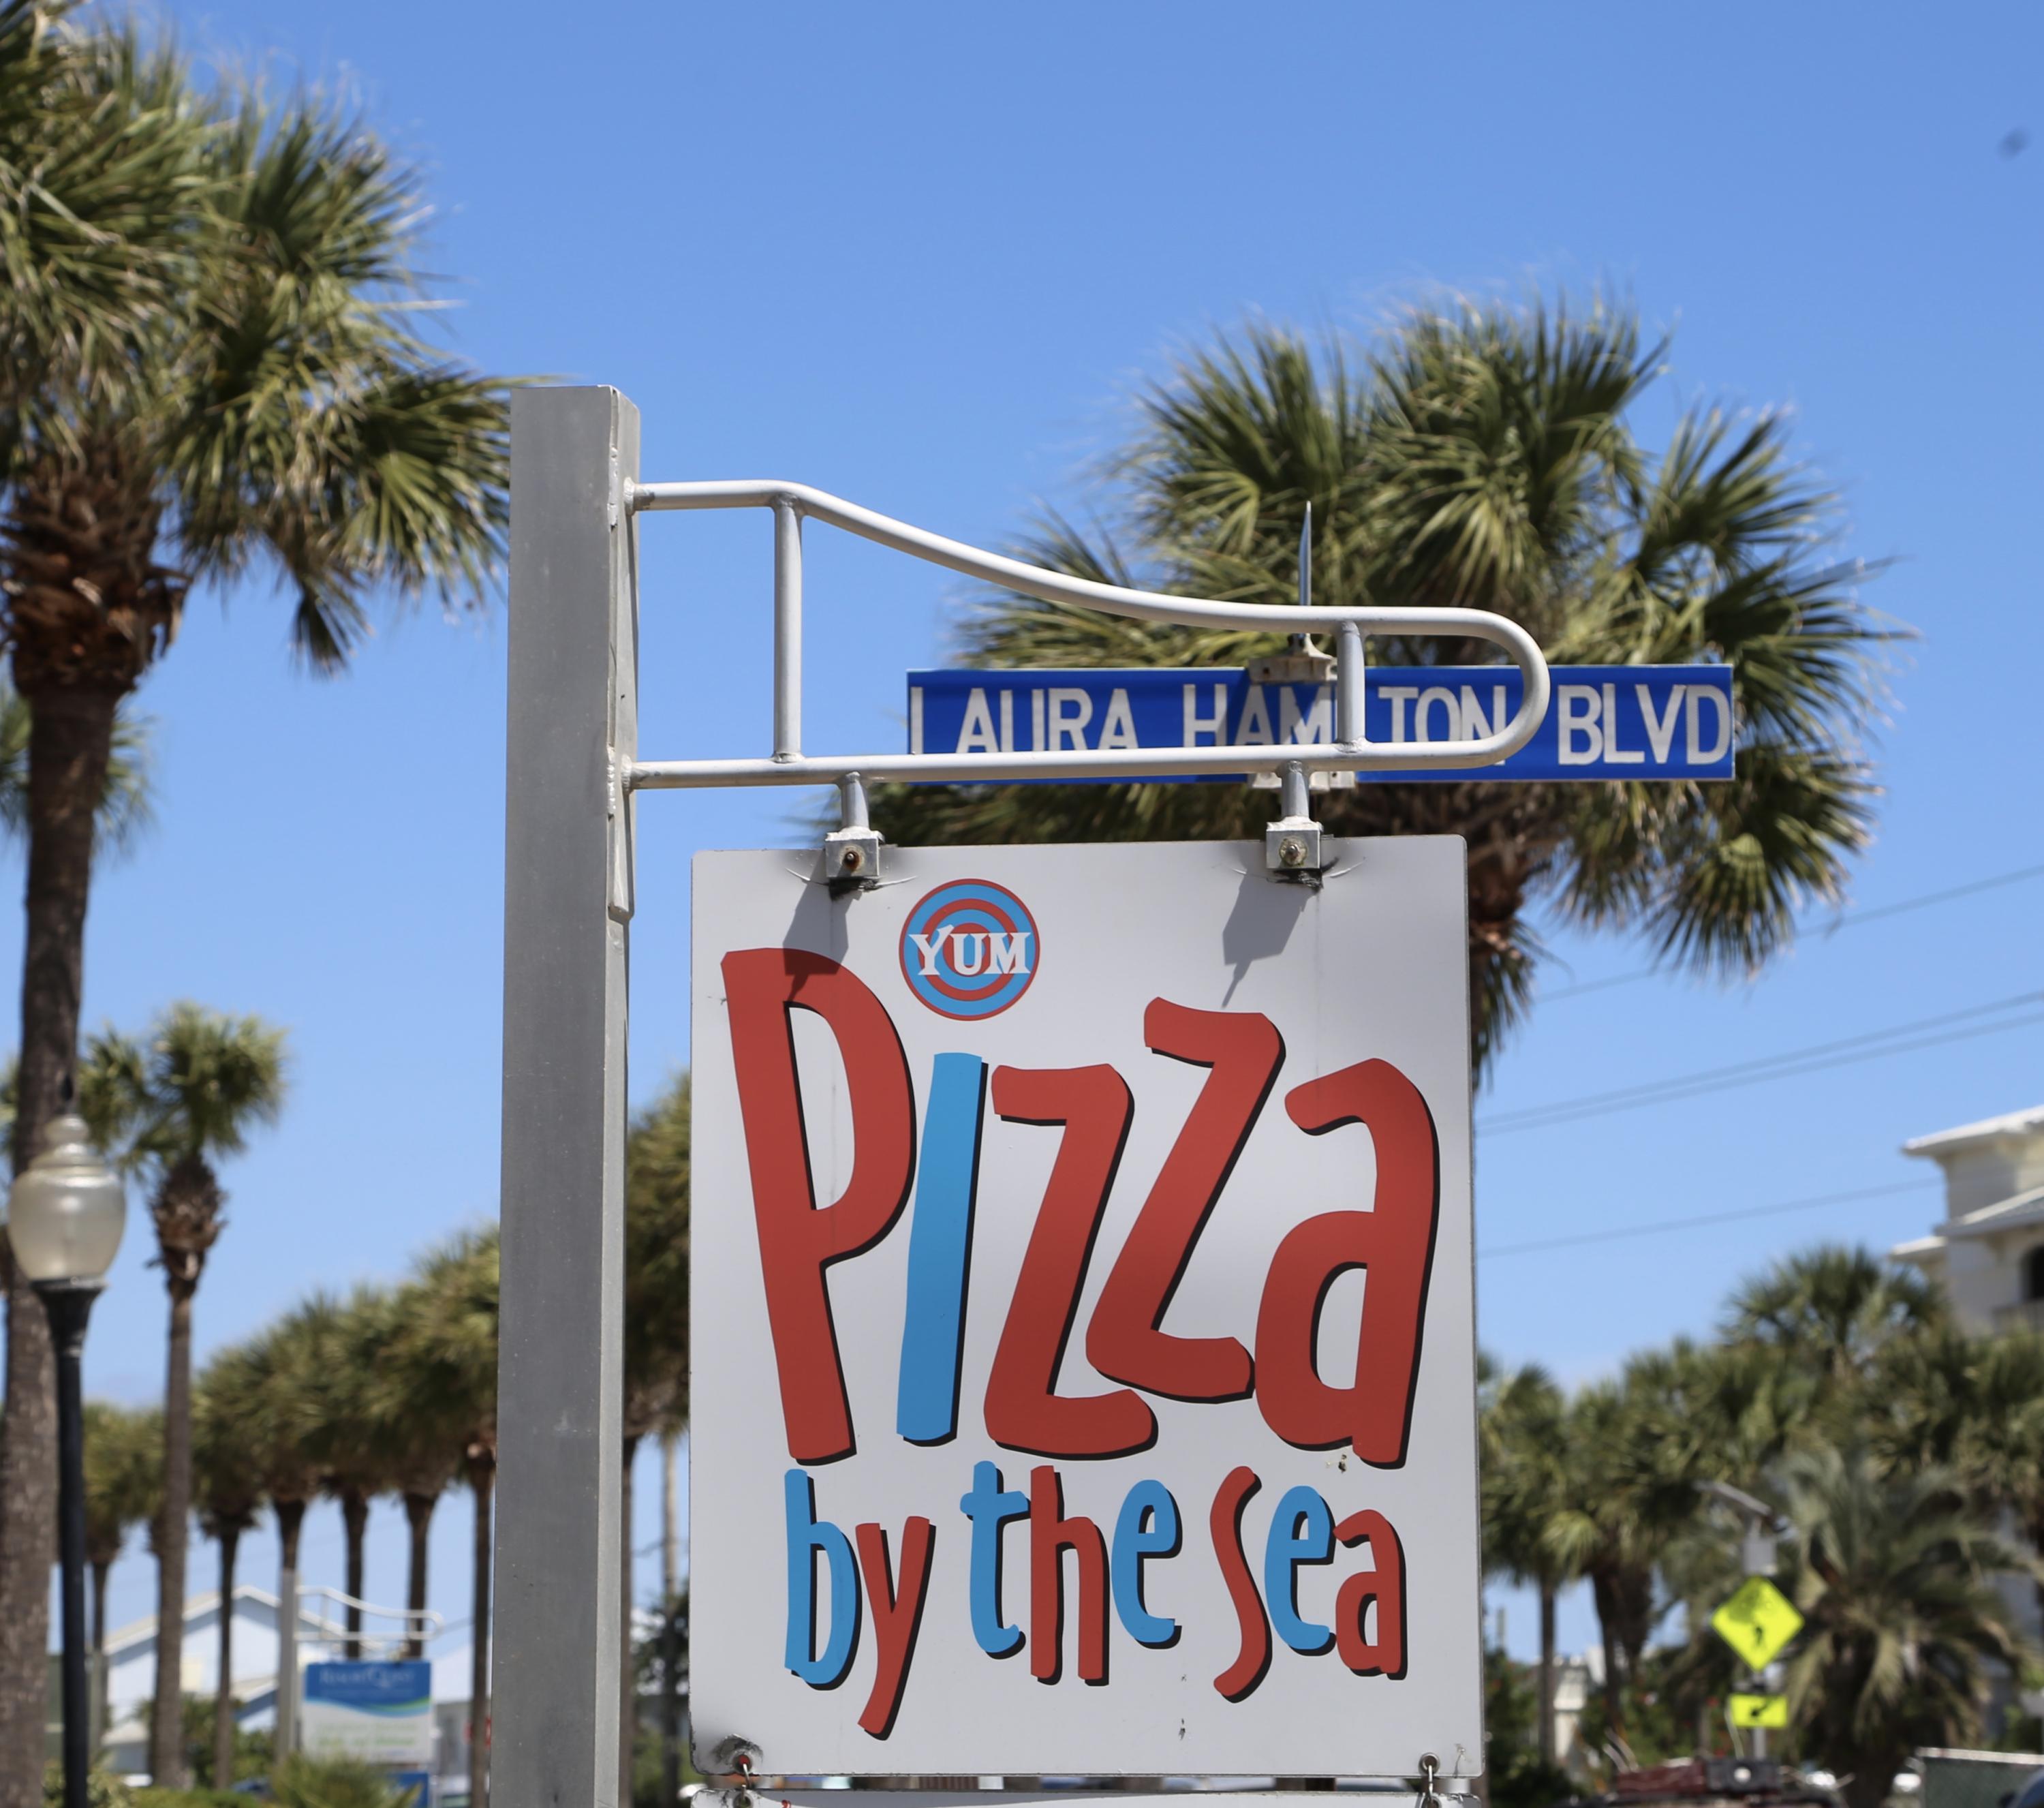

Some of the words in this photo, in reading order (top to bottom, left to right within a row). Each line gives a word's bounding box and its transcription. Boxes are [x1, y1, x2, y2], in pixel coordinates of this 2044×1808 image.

[1183, 684, 1507, 765] HAMTON
[1558, 683, 1731, 765] BLVD
[908, 923, 1031, 976] YUM
[784, 1468, 935, 1740] by
[959, 1460, 1183, 1686] the
